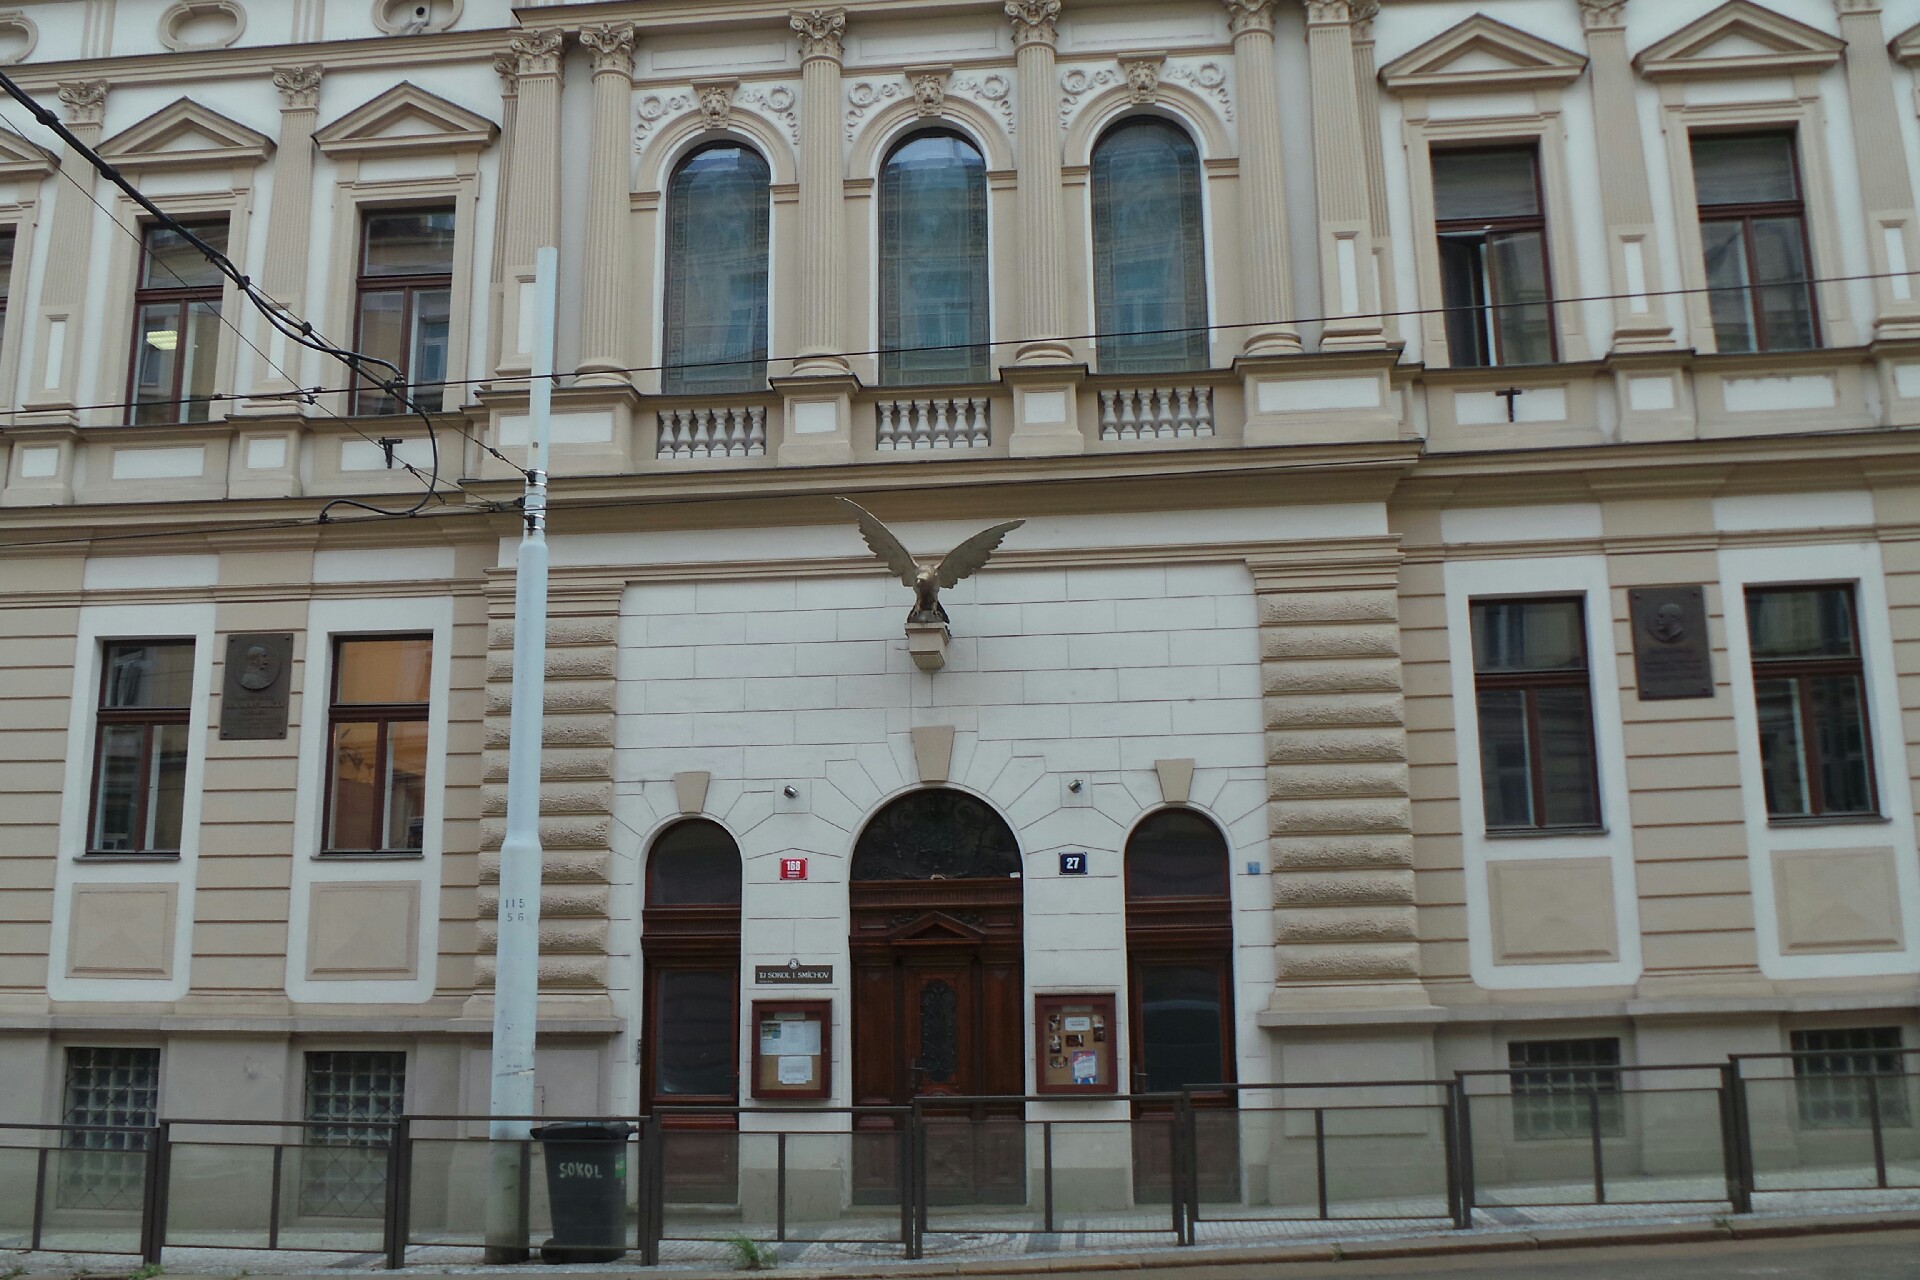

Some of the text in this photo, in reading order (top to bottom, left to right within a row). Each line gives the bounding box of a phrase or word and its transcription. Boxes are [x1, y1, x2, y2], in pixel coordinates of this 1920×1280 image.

[786, 860, 801, 871] 168
[1066, 857, 1080, 869] 27
[507, 912, 524, 923] 56
[768, 971, 791, 979] SOKOL
[798, 970, 829, 979] SMÍCHOV
[559, 1161, 603, 1178] SOKOL
